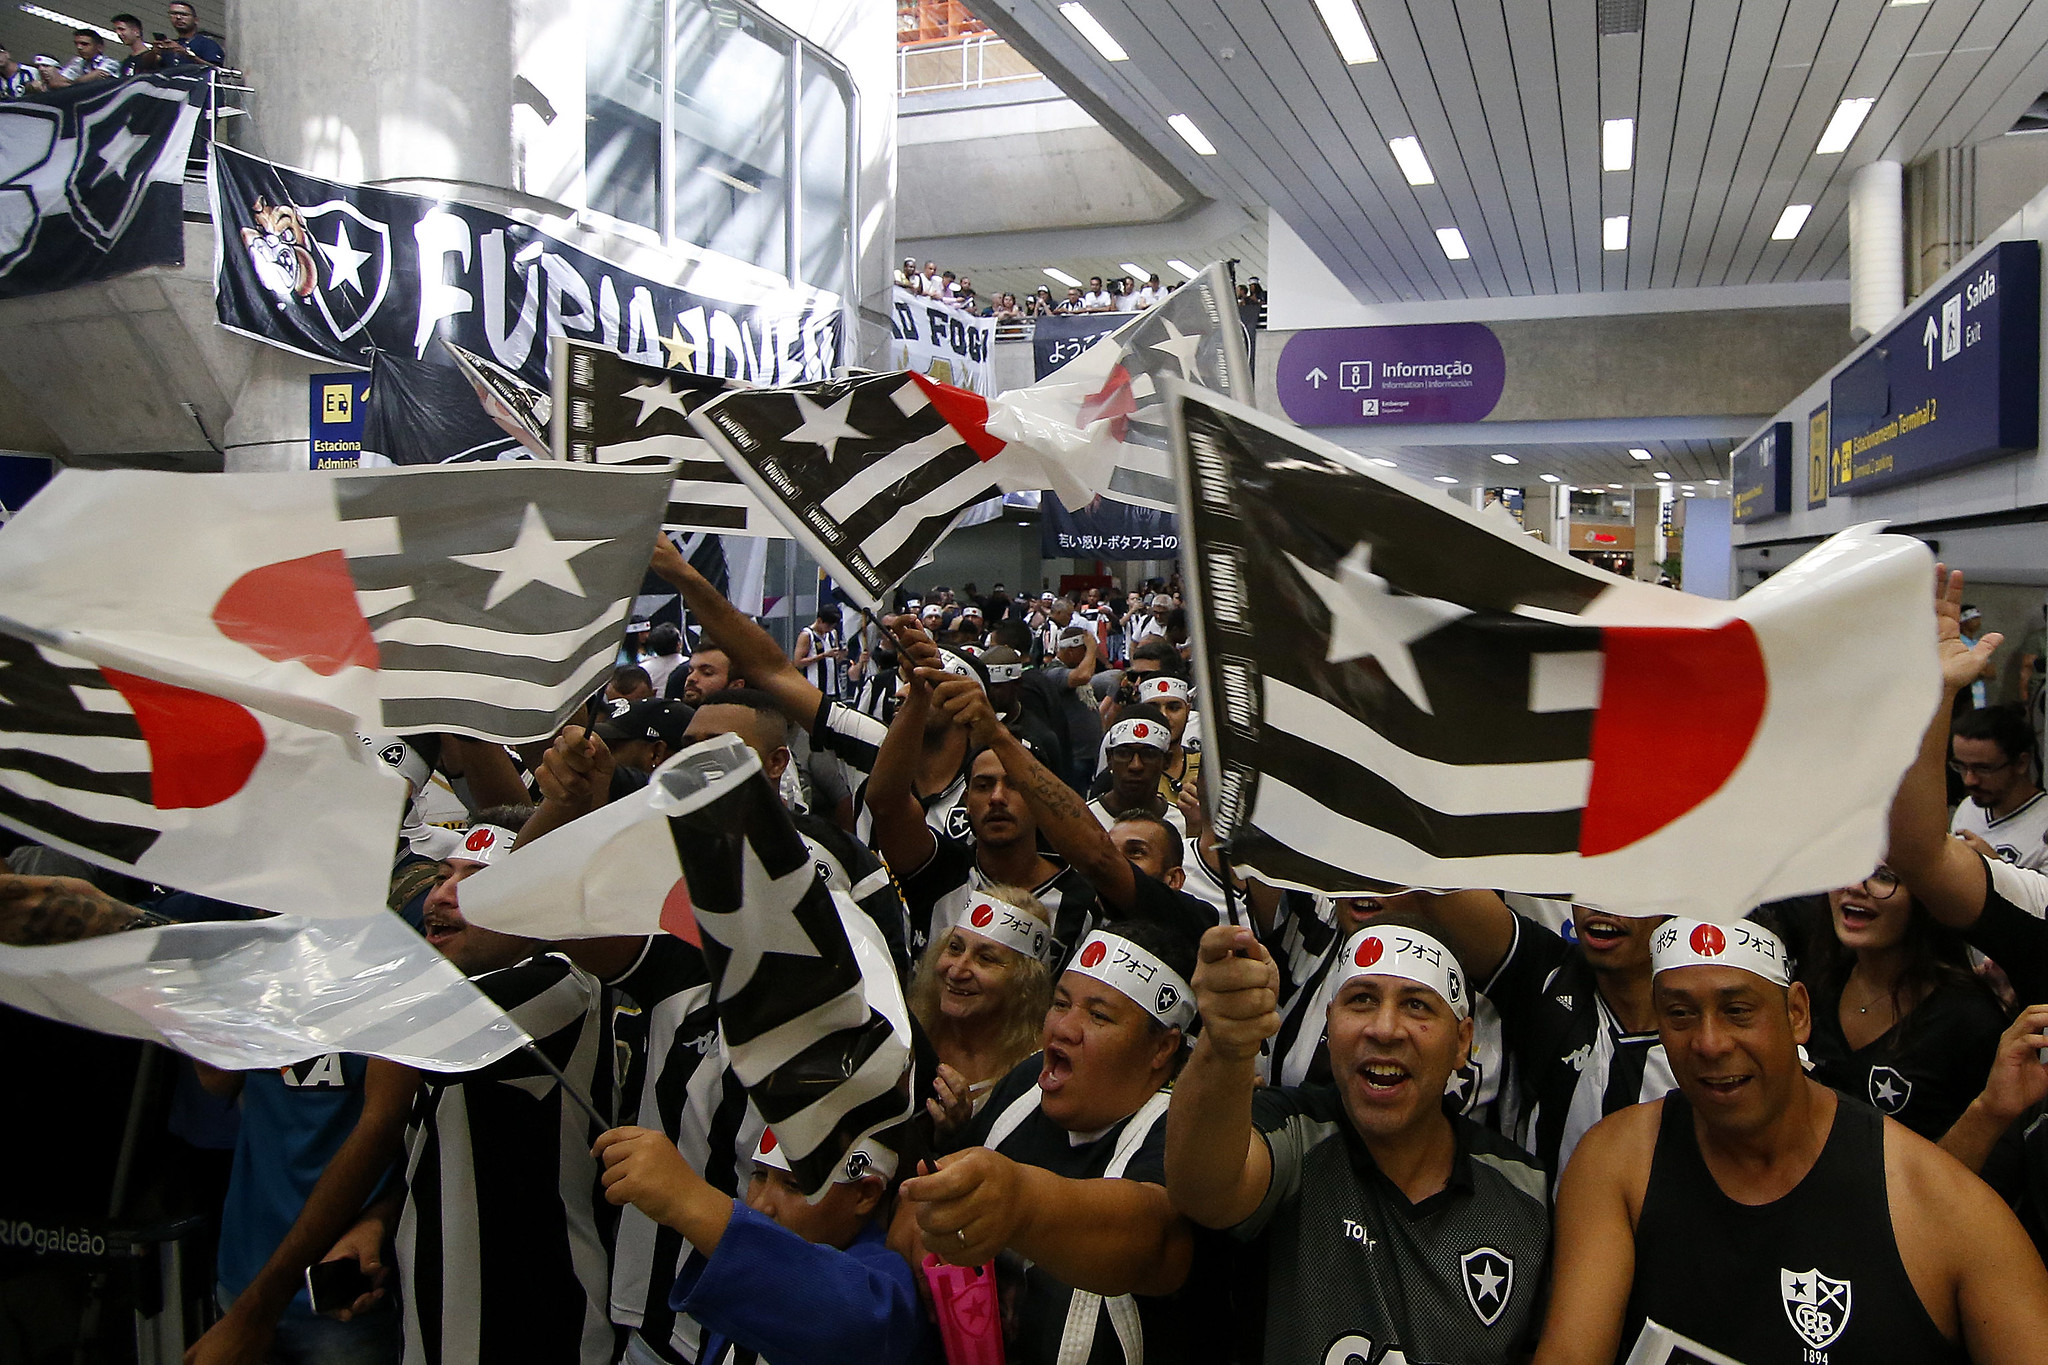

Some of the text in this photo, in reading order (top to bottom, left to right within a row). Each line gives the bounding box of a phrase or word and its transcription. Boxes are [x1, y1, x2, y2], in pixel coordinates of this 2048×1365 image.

[1966, 270, 1996, 311] Saída
[1966, 321, 1982, 348] Exit
[1382, 360, 1473, 379] Informação
[1382, 381, 1424, 389] Information
[1367, 401, 1375, 413] 2
[1899, 399, 1930, 434] Terminal
[1930, 398, 1937, 421] 2
[314, 439, 362, 452] Estaciona
[1000, 912, 1034, 937] フォゴ
[1395, 937, 1442, 968] フォゴ
[1734, 927, 1777, 960] フォゴ
[1112, 948, 1159, 984] フォゴ
[1803, 1347, 1828, 1365] 1894
